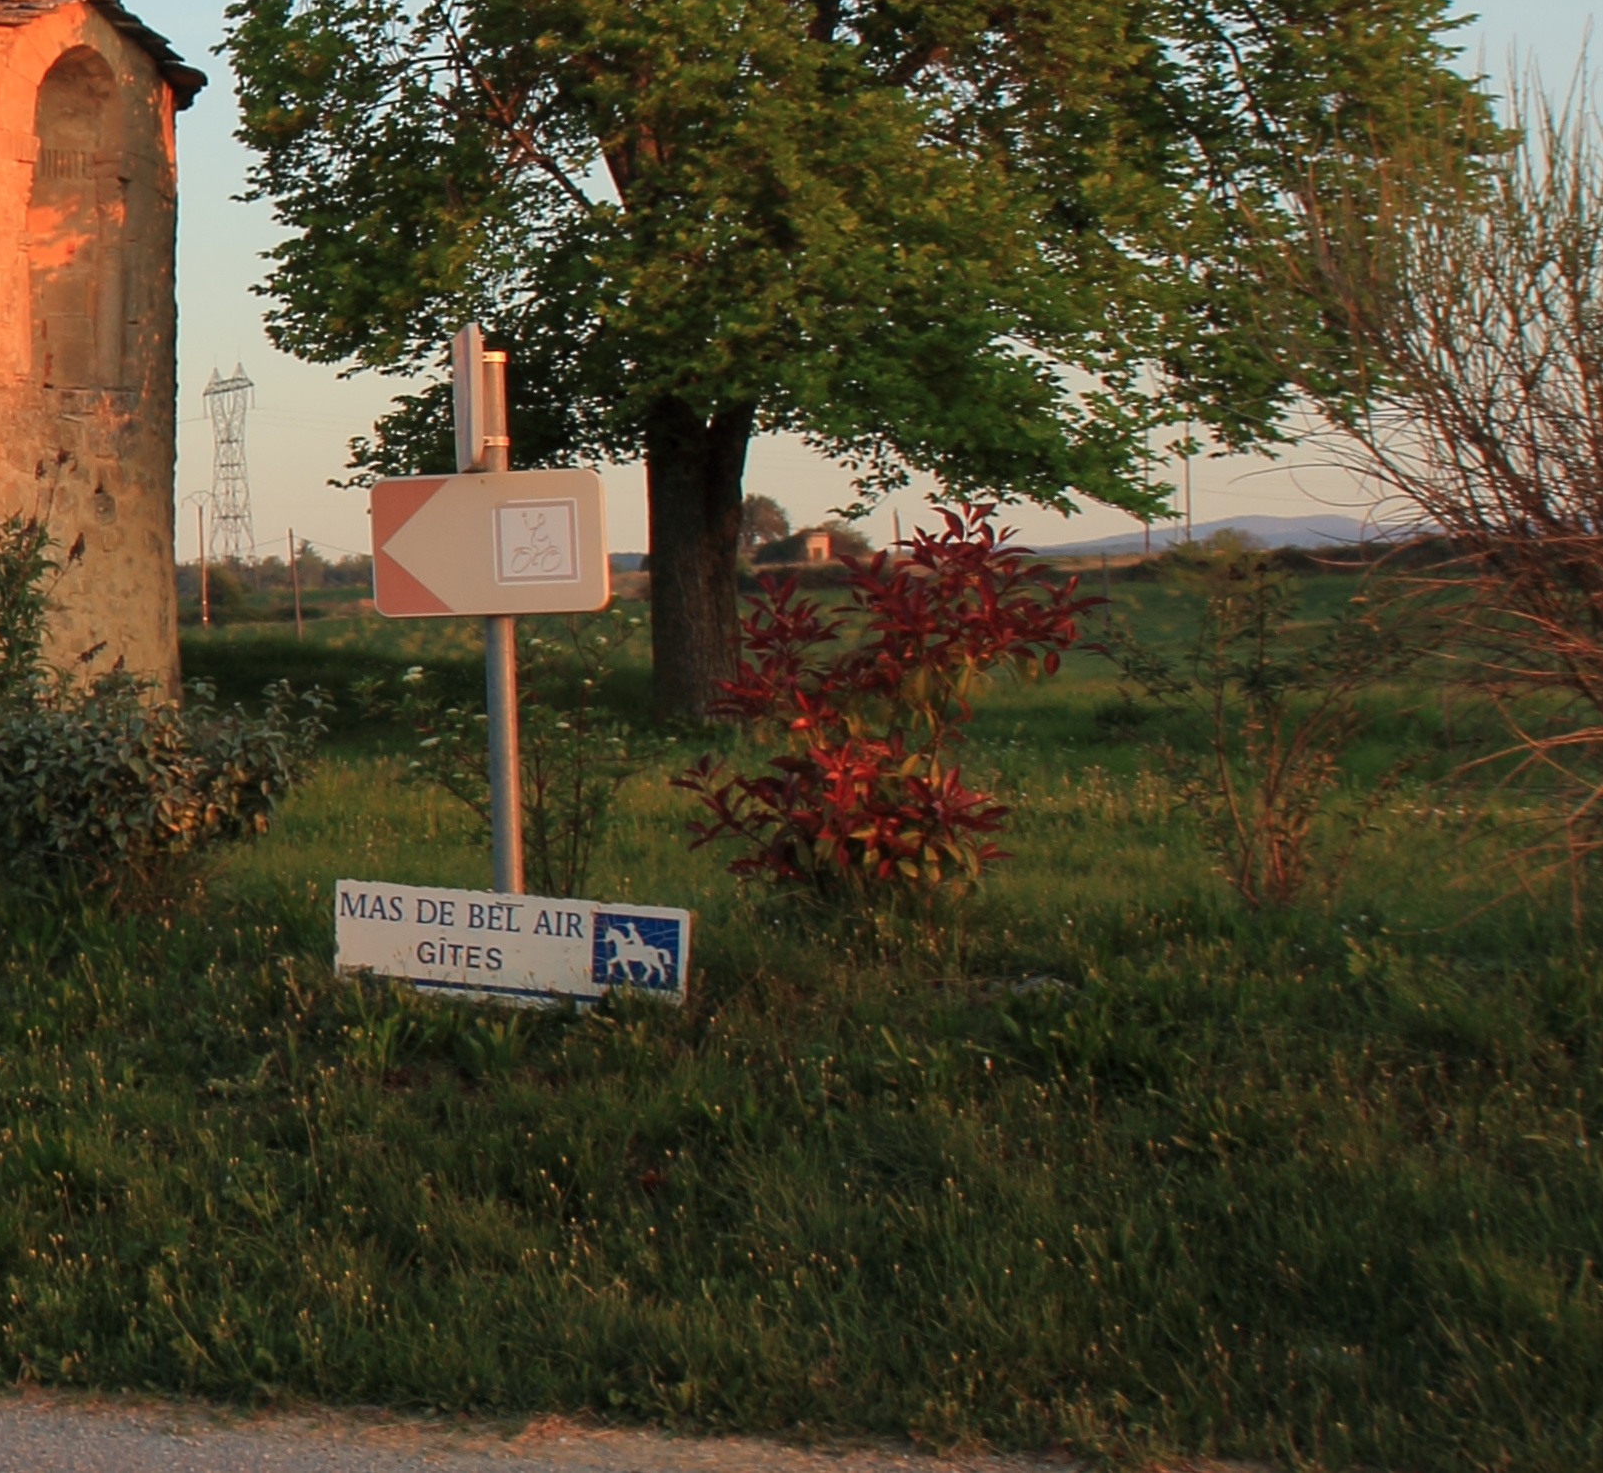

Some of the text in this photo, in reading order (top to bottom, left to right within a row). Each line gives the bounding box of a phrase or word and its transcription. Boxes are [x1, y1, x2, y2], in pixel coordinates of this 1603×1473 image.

[339, 891, 584, 938] MAS DE BEL AIR
[417, 937, 503, 970] GÎTES
